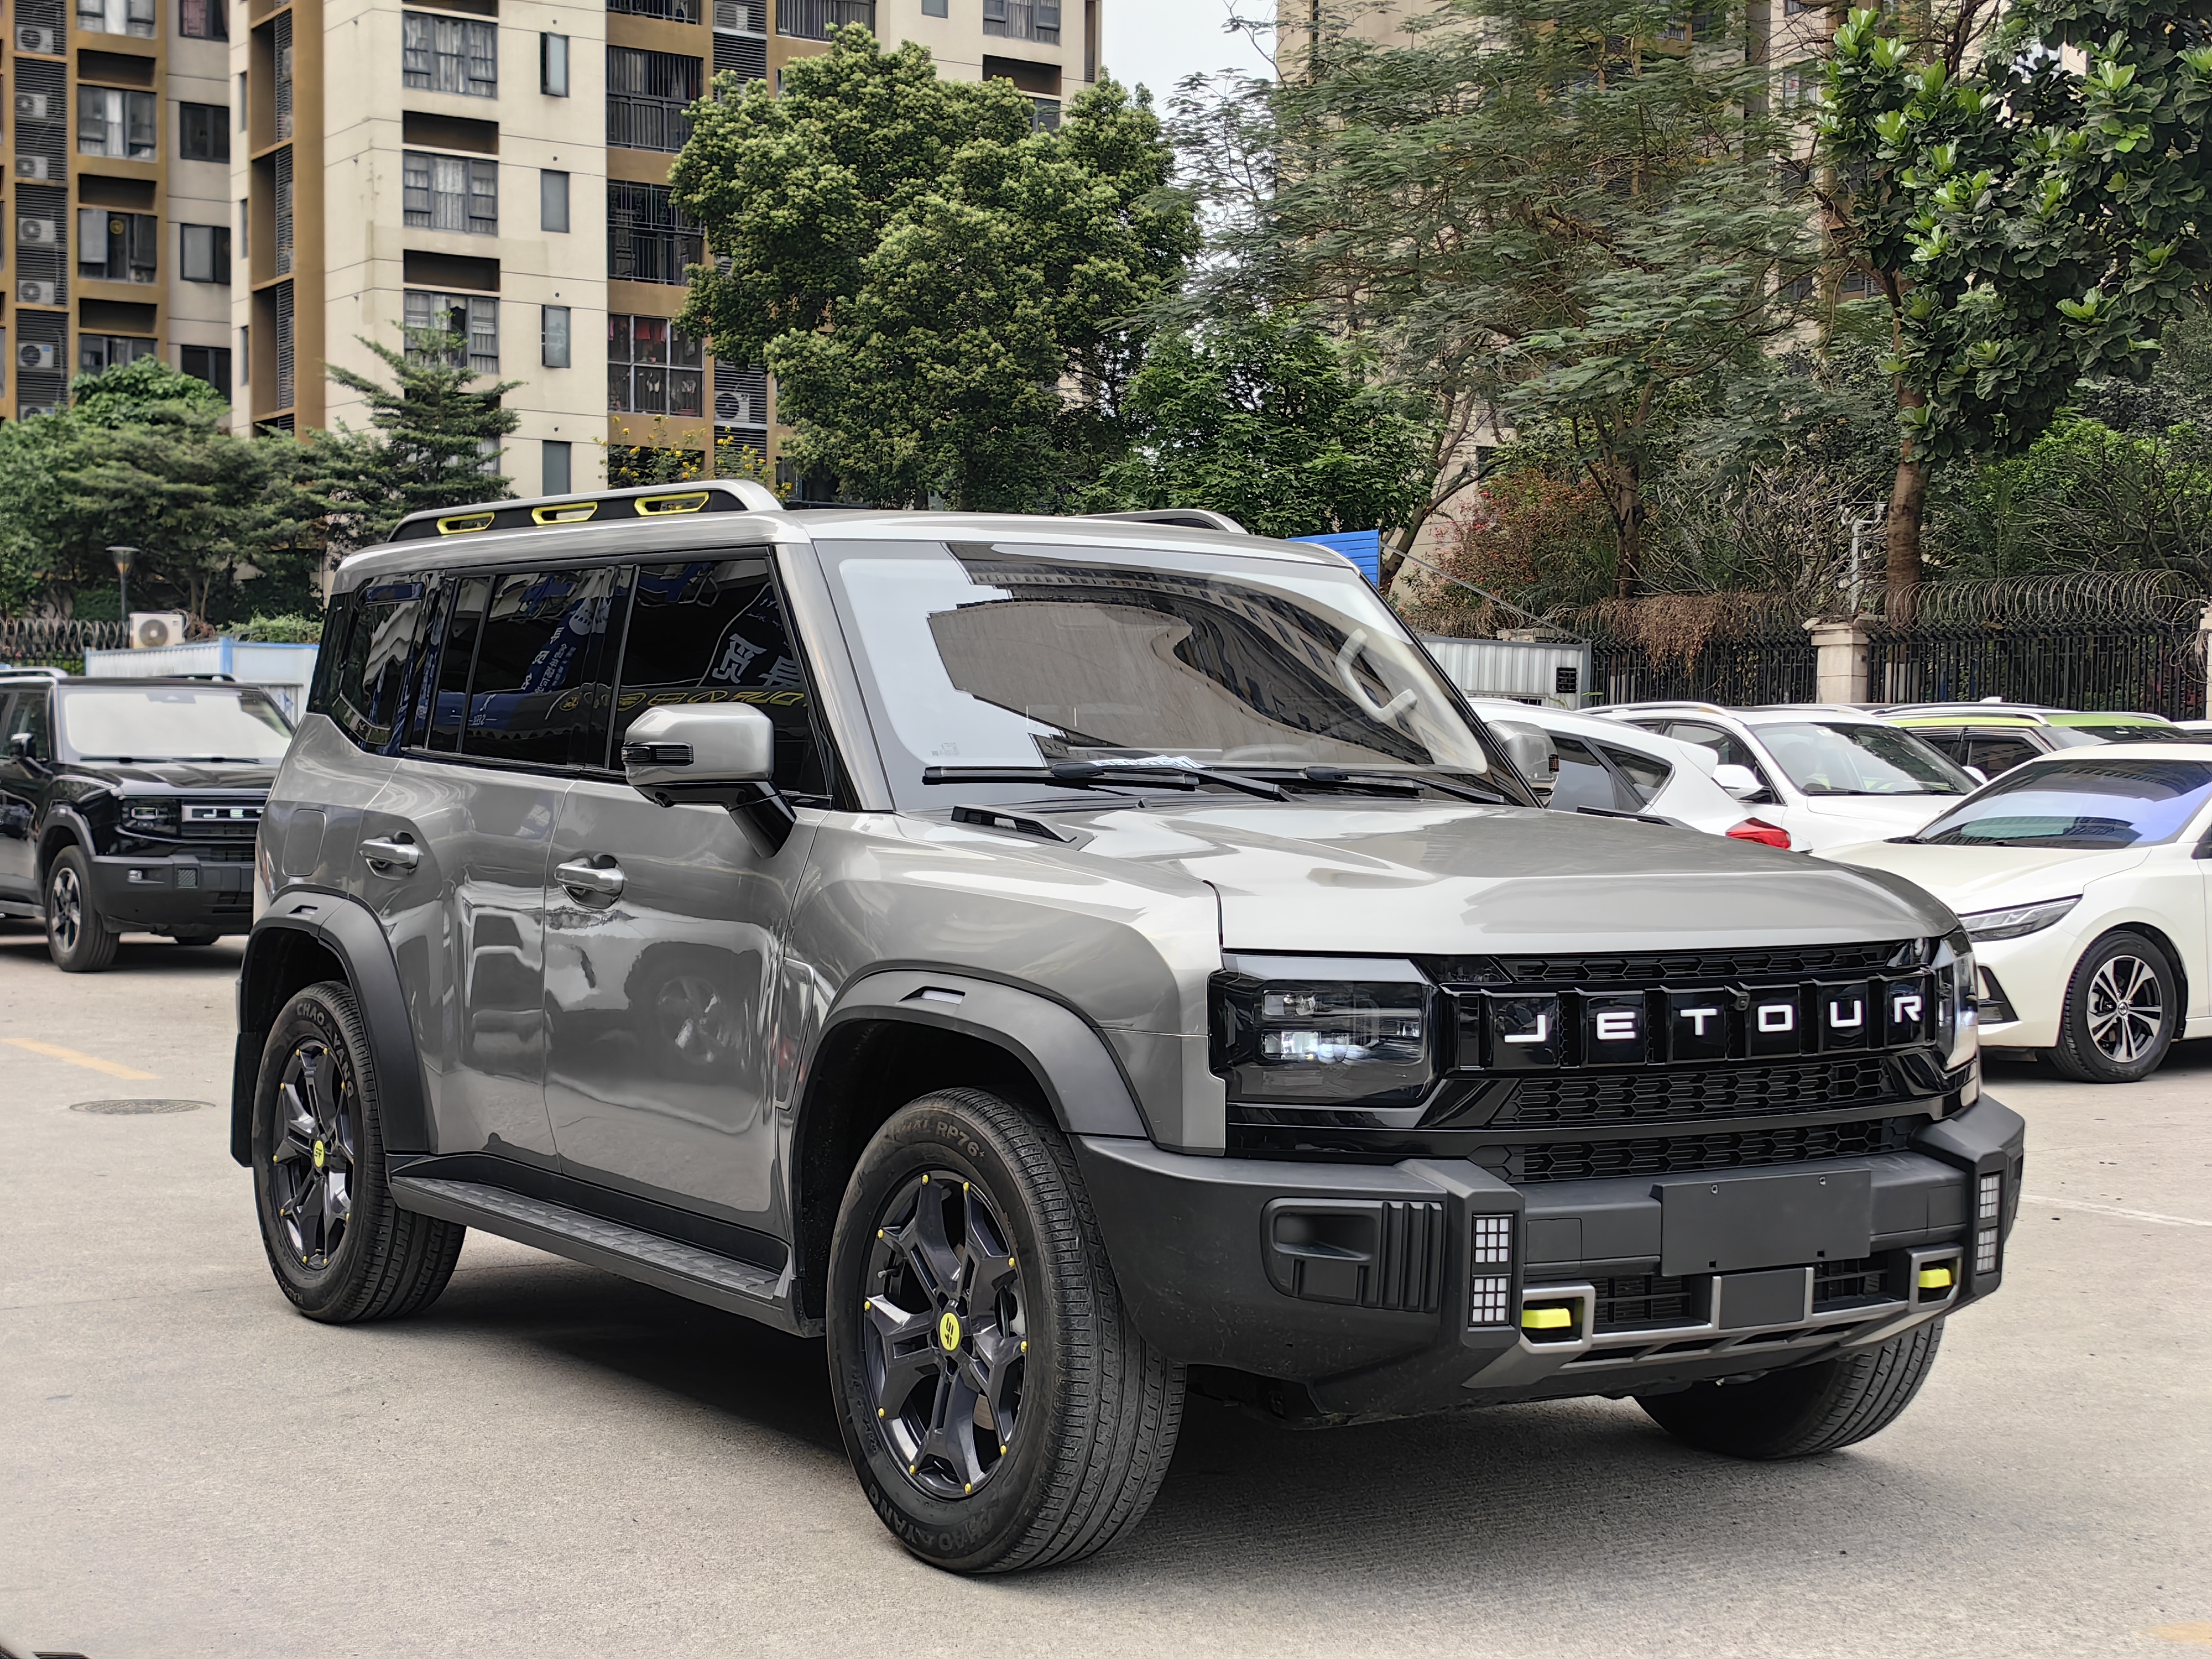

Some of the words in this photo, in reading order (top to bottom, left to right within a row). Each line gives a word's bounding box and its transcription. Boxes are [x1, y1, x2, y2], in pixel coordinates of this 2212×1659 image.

[202, 808, 265, 818] JE
[296, 1003, 325, 1026] CHAO
[1504, 996, 1922, 1043] JETOUR
